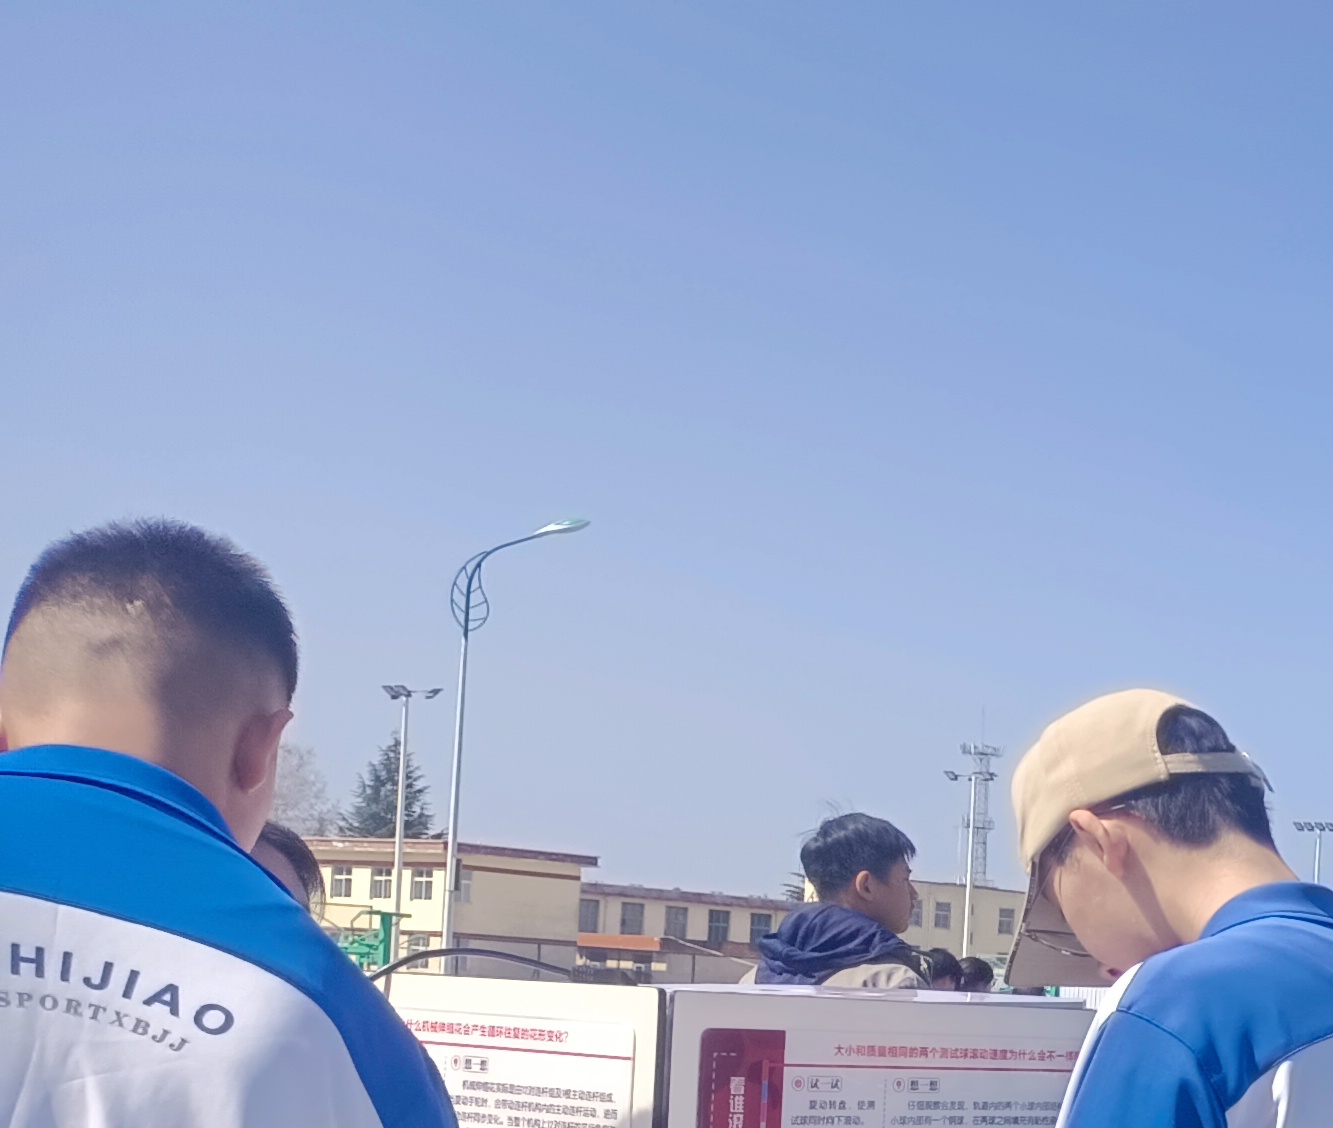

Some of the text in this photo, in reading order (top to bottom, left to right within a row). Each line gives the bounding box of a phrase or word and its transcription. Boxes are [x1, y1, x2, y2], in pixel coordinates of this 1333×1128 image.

[10, 942, 235, 1036] HIJIAO
[834, 1044, 1079, 1062] 大小和质量相同的两个测试球滚动速度为什么会不一样
[810, 1077, 840, 1090] 试一试
[910, 1079, 939, 1092] 想一想
